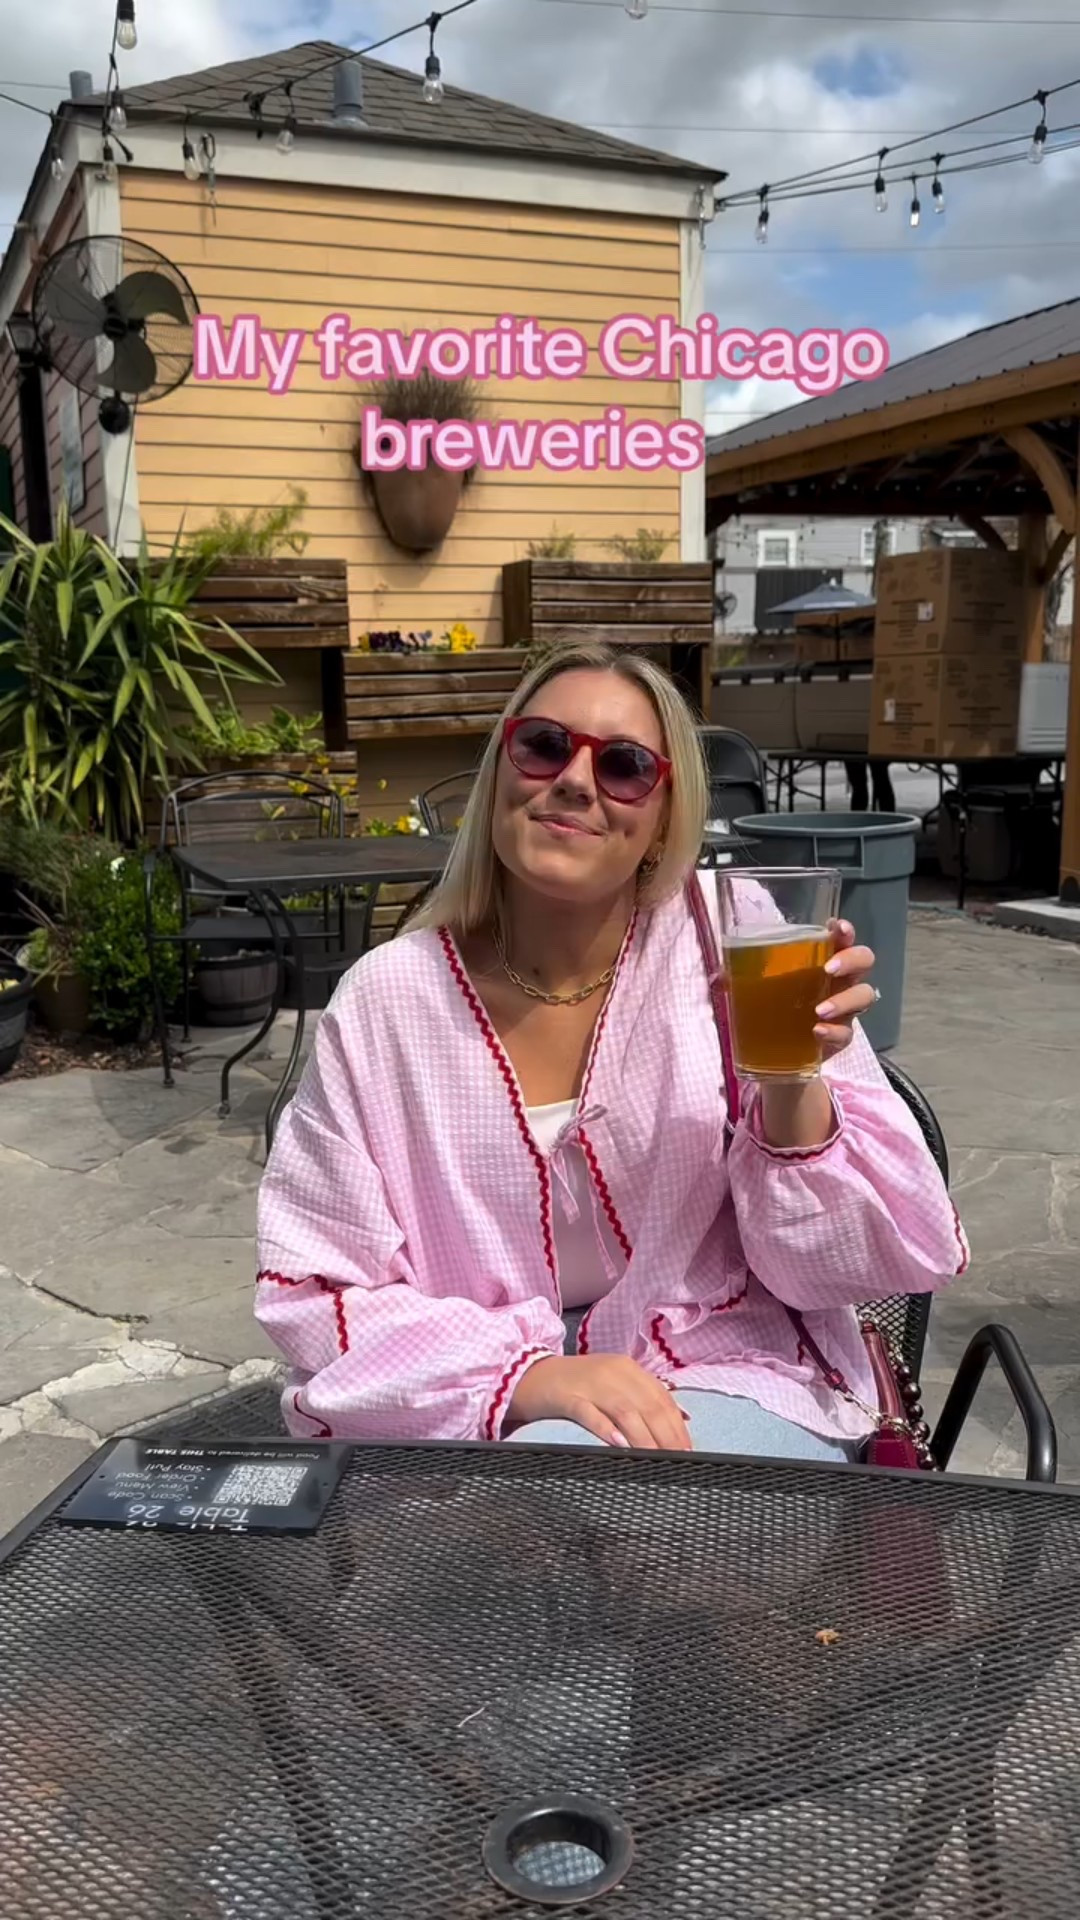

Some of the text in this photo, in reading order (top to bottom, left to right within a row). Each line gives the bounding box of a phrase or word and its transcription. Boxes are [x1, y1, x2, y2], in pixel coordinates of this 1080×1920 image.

[175, 1463, 204, 1473] Stay
[115, 1472, 197, 1482] Order Food
[115, 1481, 190, 1492] View Menu
[107, 1491, 184, 1502] Scan Code
[127, 1504, 249, 1523] Table 26
